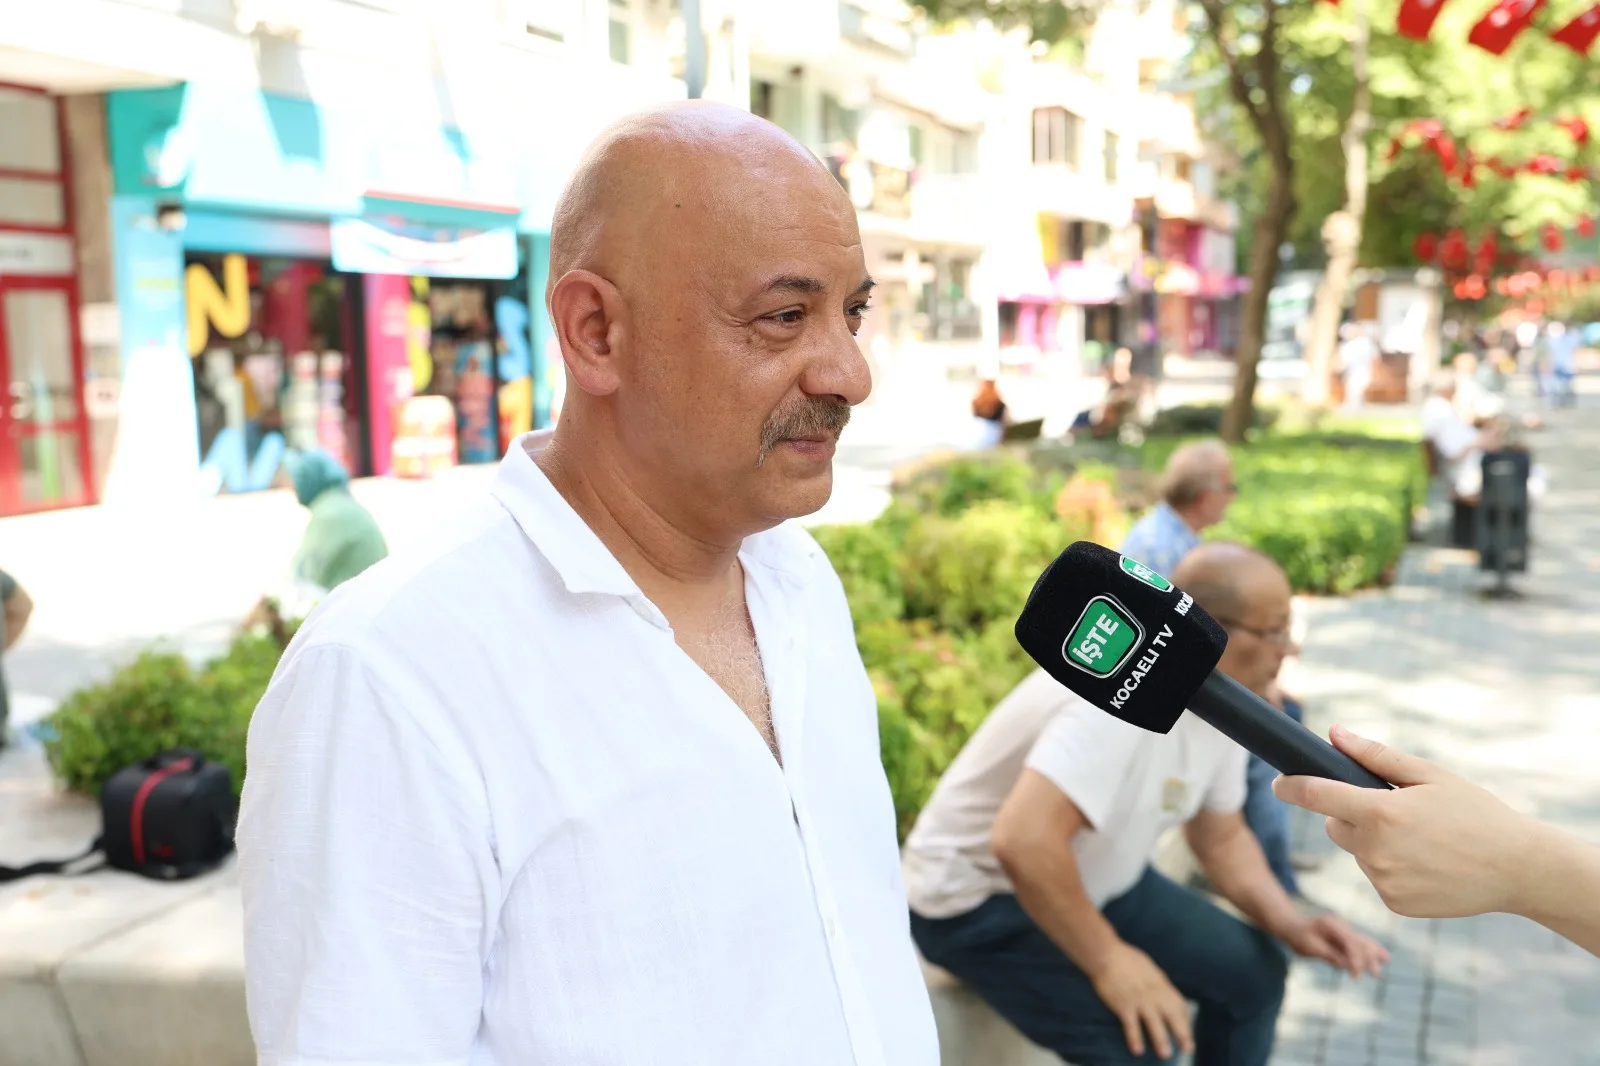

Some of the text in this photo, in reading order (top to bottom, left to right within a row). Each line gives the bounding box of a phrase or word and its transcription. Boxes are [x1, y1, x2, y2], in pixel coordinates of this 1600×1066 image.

[1072, 613, 1119, 665] İŞTE
[1109, 623, 1174, 709] KOCAELI TV
